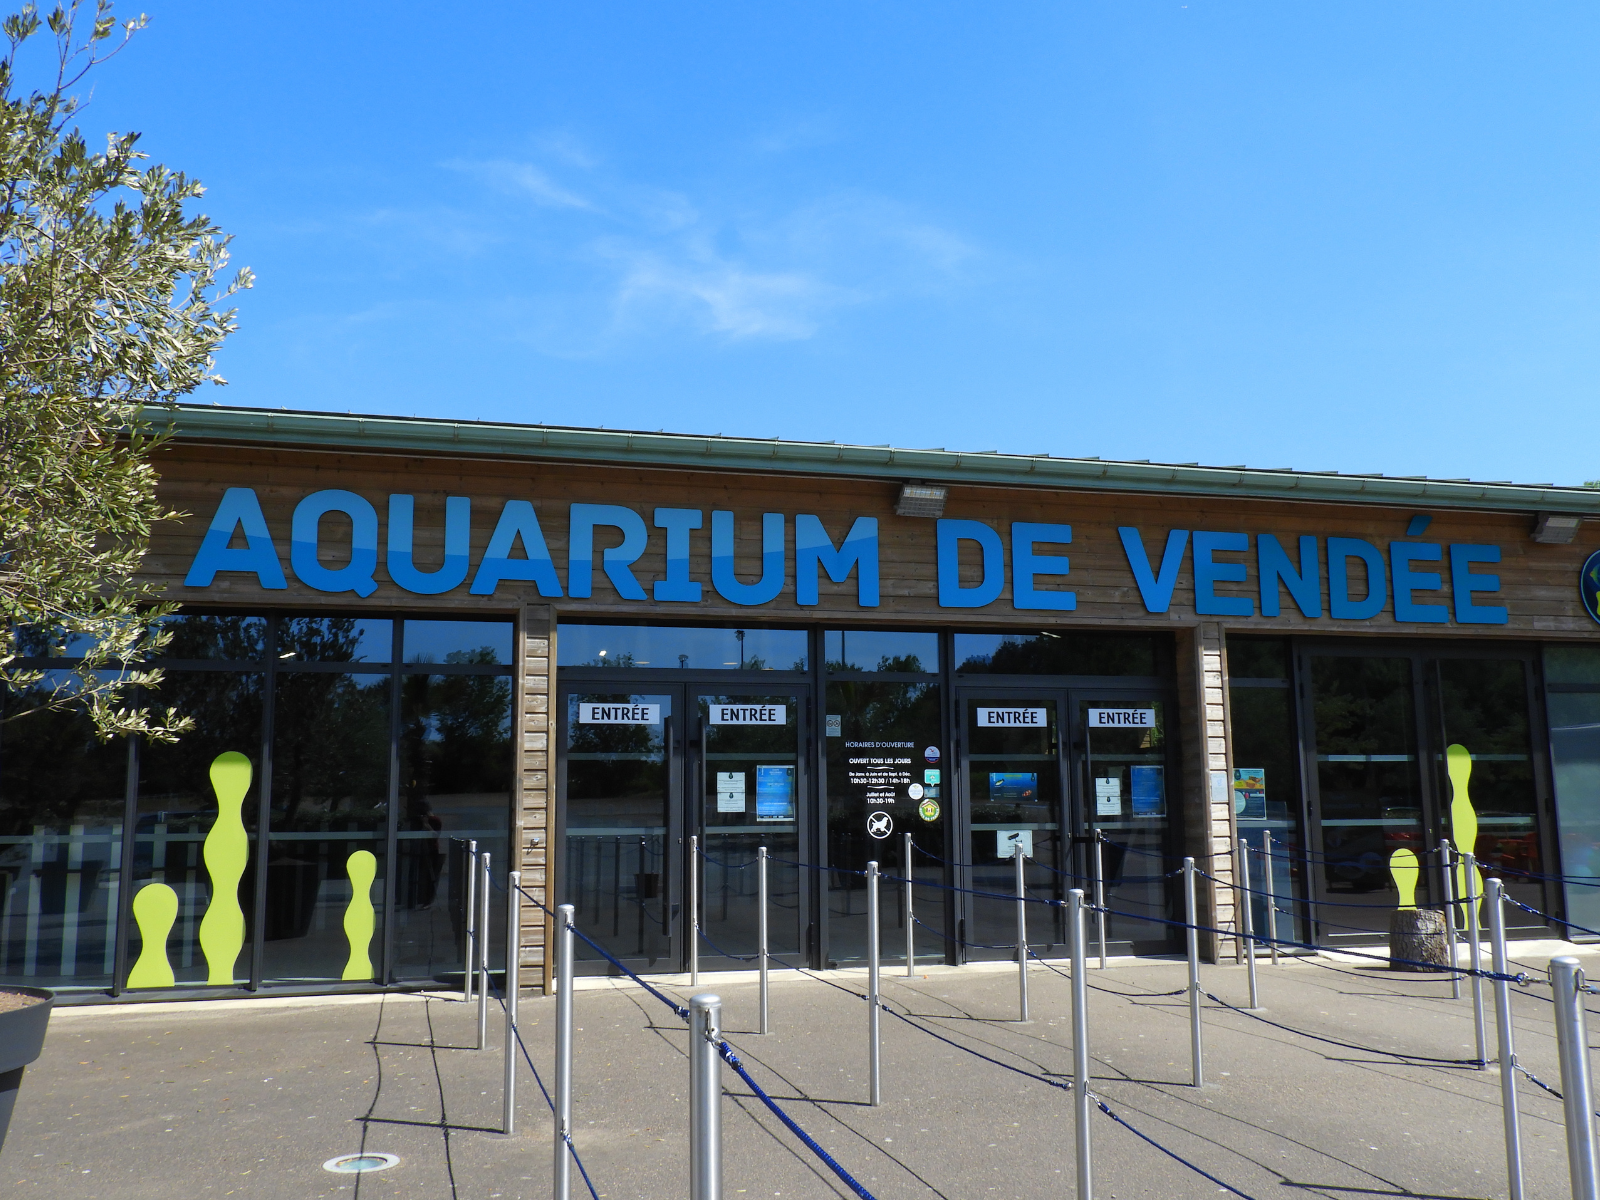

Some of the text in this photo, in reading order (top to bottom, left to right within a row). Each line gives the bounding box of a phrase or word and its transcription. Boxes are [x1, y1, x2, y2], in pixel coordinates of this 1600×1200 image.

[183, 486, 1508, 625] AQUARIUM DE VENDÉE
[591, 704, 650, 721] ENTRÉE
[720, 705, 776, 722] ENTRÉE
[988, 709, 1038, 724] ENTRÉE
[1099, 709, 1147, 725] ENTRÉE
